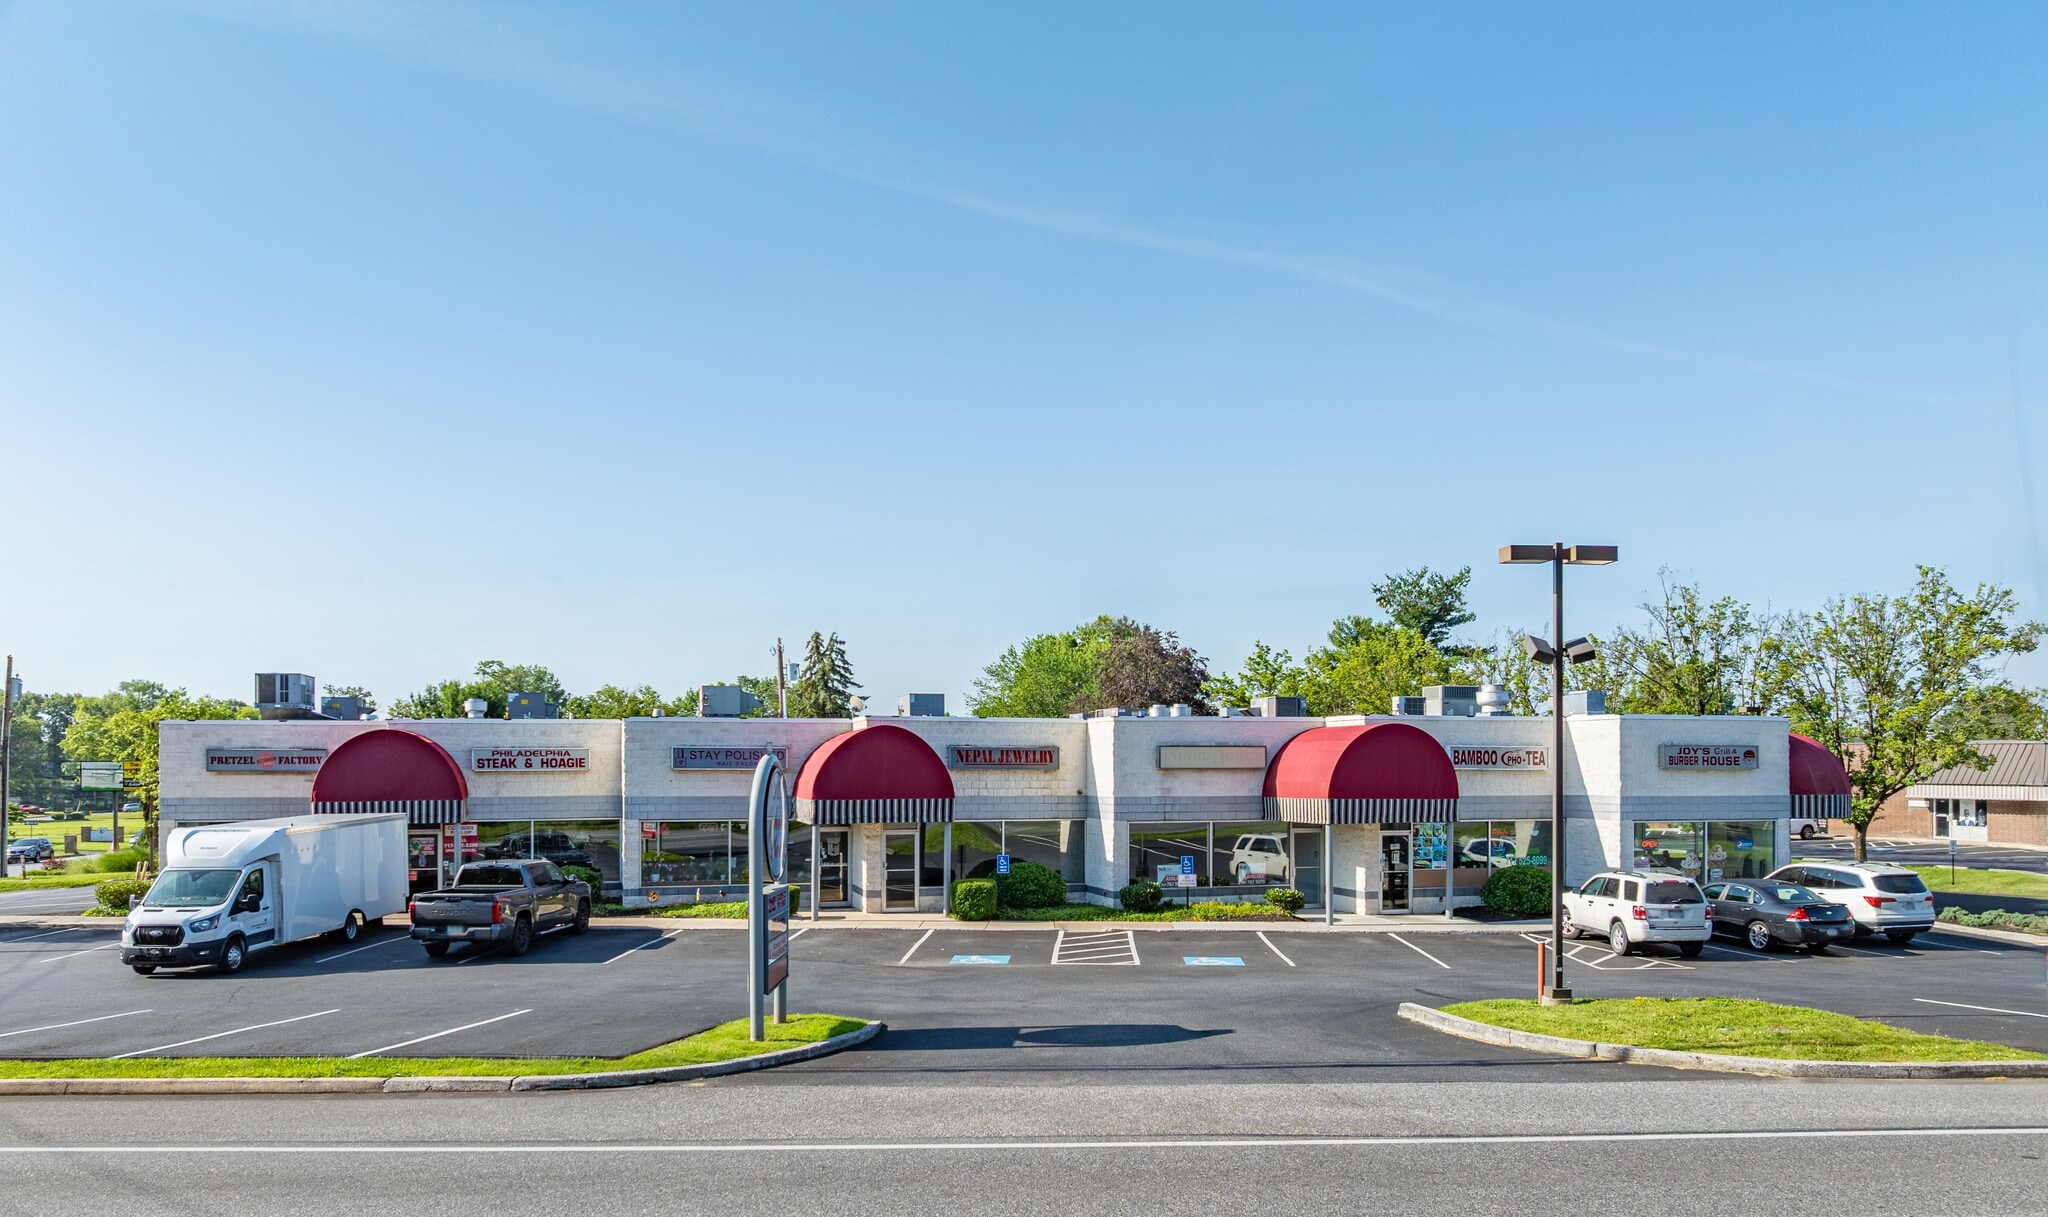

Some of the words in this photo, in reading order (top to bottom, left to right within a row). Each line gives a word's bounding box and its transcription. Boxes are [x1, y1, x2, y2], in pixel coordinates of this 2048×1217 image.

[210, 756, 255, 764] PRETZEL
[278, 756, 322, 764] FACTORY
[689, 751, 721, 760] STAY
[725, 751, 785, 760] POLISD
[956, 749, 995, 763] NEPAL
[998, 749, 1055, 763] JEWELRY
[1453, 750, 1498, 765] BAMBOO
[1526, 751, 1546, 766] TEA
[477, 758, 517, 769] STEAK
[524, 758, 533, 768] &
[541, 758, 585, 768] HOAGIE
[1669, 756, 1699, 766] BURGER
[1702, 757, 1740, 766] HOUSE
[1641, 840, 1658, 848] OPEN
